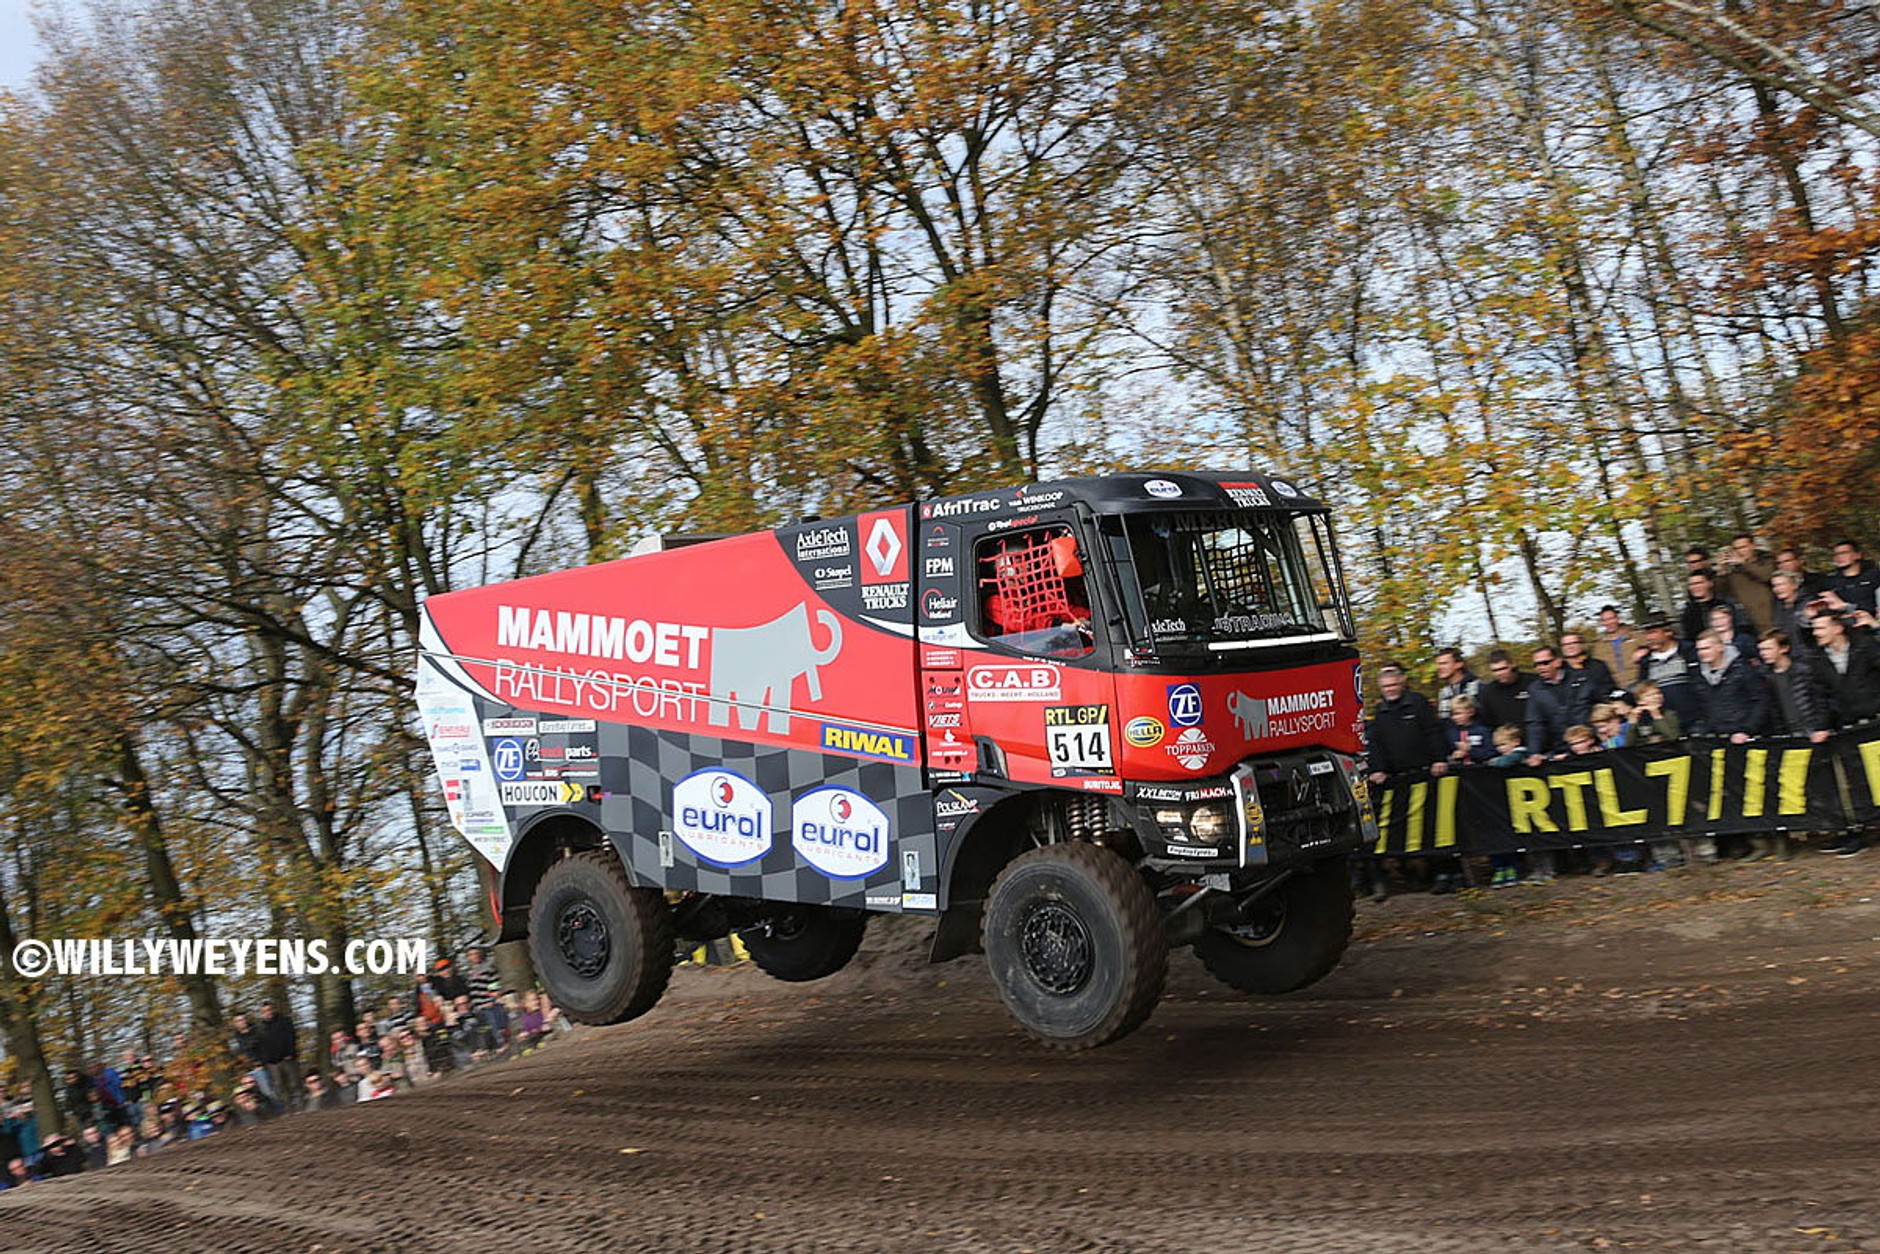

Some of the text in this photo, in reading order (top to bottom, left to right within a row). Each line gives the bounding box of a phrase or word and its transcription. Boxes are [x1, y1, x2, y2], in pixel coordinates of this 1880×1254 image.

[932, 498, 1000, 518] AfriTrac
[797, 527, 849, 548] AxleTech
[926, 557, 953, 574] FPM
[861, 584, 910, 598] RENAULT
[864, 596, 907, 609] TRUCKS
[497, 605, 709, 669] MAMMOET
[495, 658, 706, 722] RALLYSPORT
[1267, 690, 1334, 716] MAMMOET
[1046, 708, 1075, 725] RTL
[1171, 691, 1201, 720] ZF
[1269, 711, 1336, 737] RALLYSPORT
[824, 727, 910, 760] RIWAL
[1054, 731, 1105, 763] 514
[496, 746, 522, 775] ZF
[504, 785, 558, 803] HOUCON
[682, 806, 762, 838] eurol
[801, 820, 879, 853] eurol
